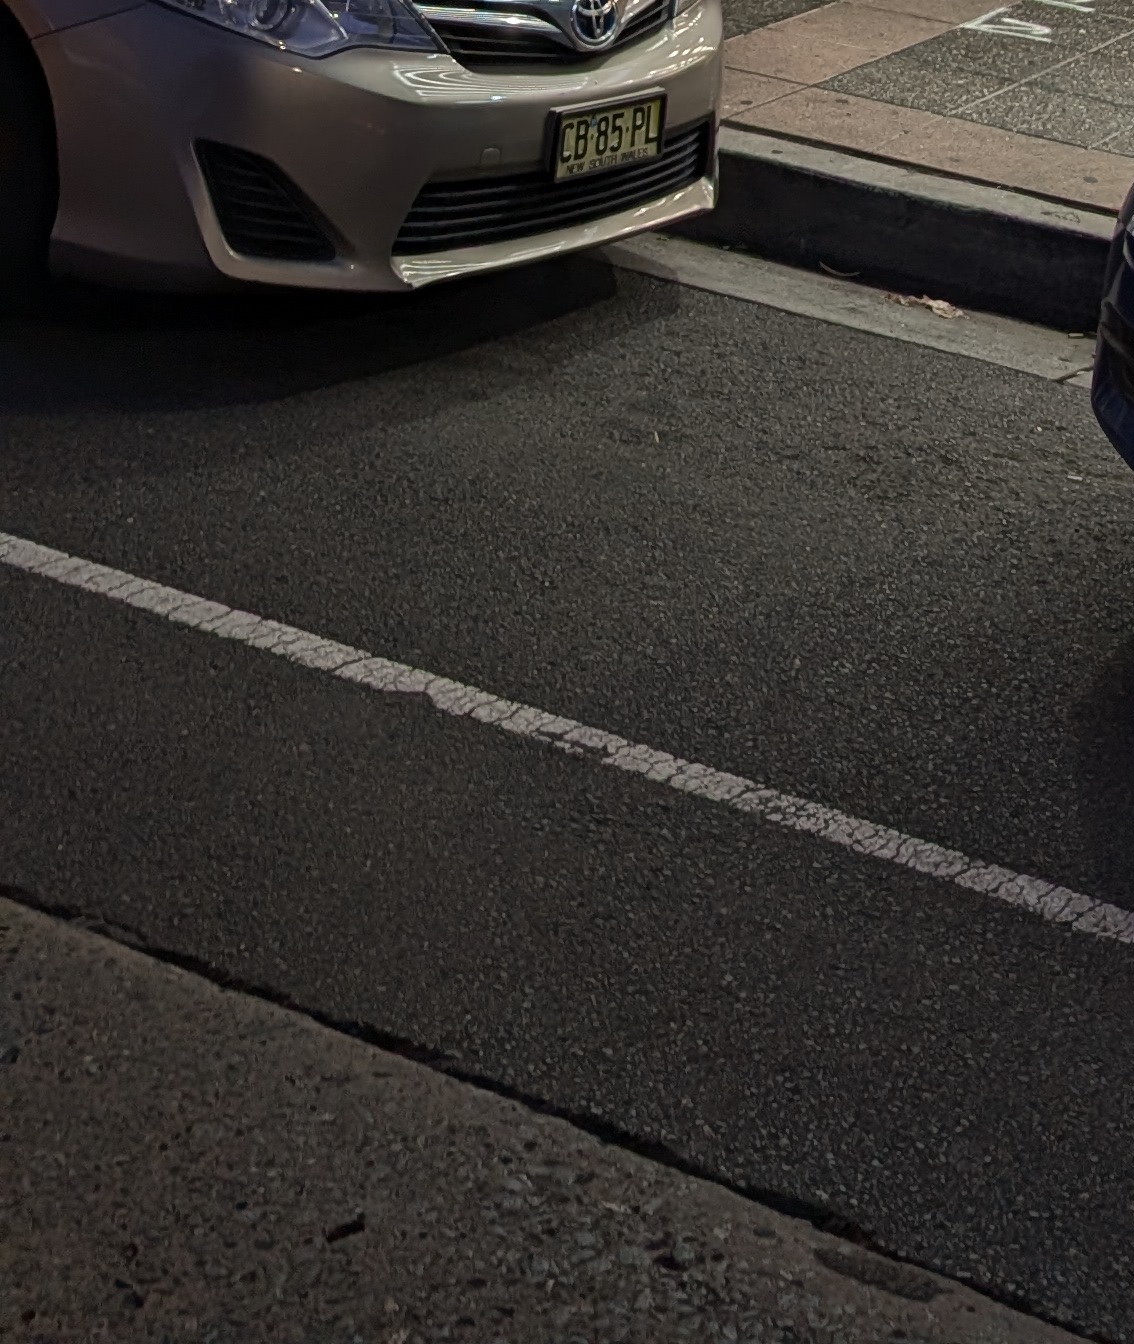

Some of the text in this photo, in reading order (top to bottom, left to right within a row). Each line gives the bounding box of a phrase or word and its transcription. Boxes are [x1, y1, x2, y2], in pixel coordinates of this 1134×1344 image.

[566, 147, 648, 174] NEW SOUTH WALES
